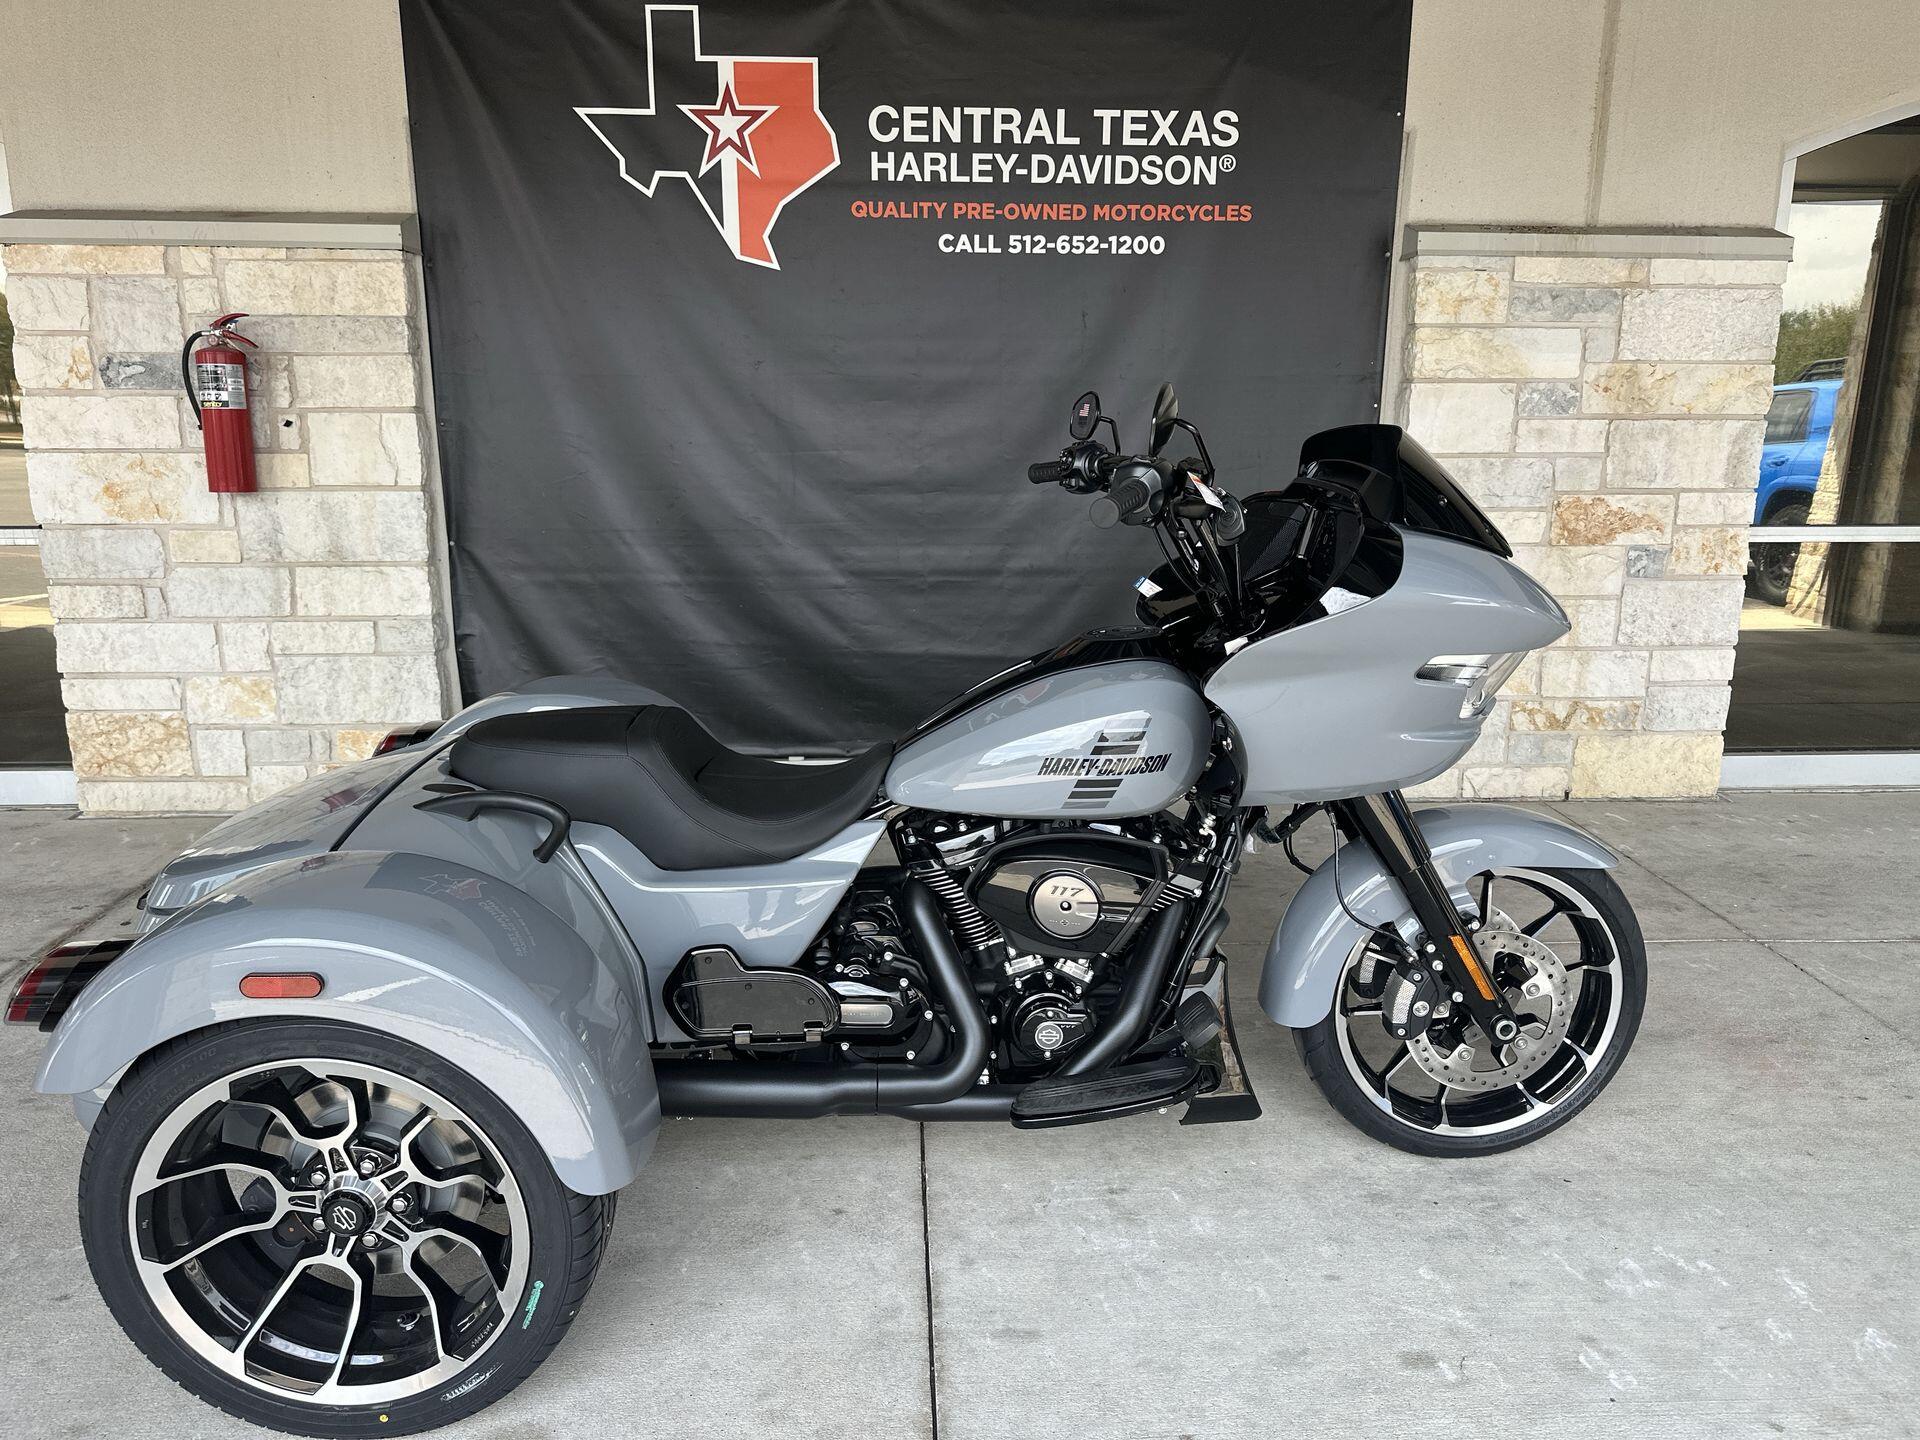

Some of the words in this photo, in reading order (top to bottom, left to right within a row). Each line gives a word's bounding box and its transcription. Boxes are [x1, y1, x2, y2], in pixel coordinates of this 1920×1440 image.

[868, 104, 1080, 145] CENTRAL
[1094, 109, 1239, 147] TEXAS
[851, 200, 946, 220] QUALITY
[953, 202, 1087, 222] PRE-OWNED
[1093, 204, 1252, 222] MOTORCYCLES
[938, 233, 1002, 254] CALL
[1008, 234, 1166, 256] 512-652-1200
[1037, 753, 1172, 776] HARLEY-DAVIDSON
[1050, 885, 1084, 897] 117
